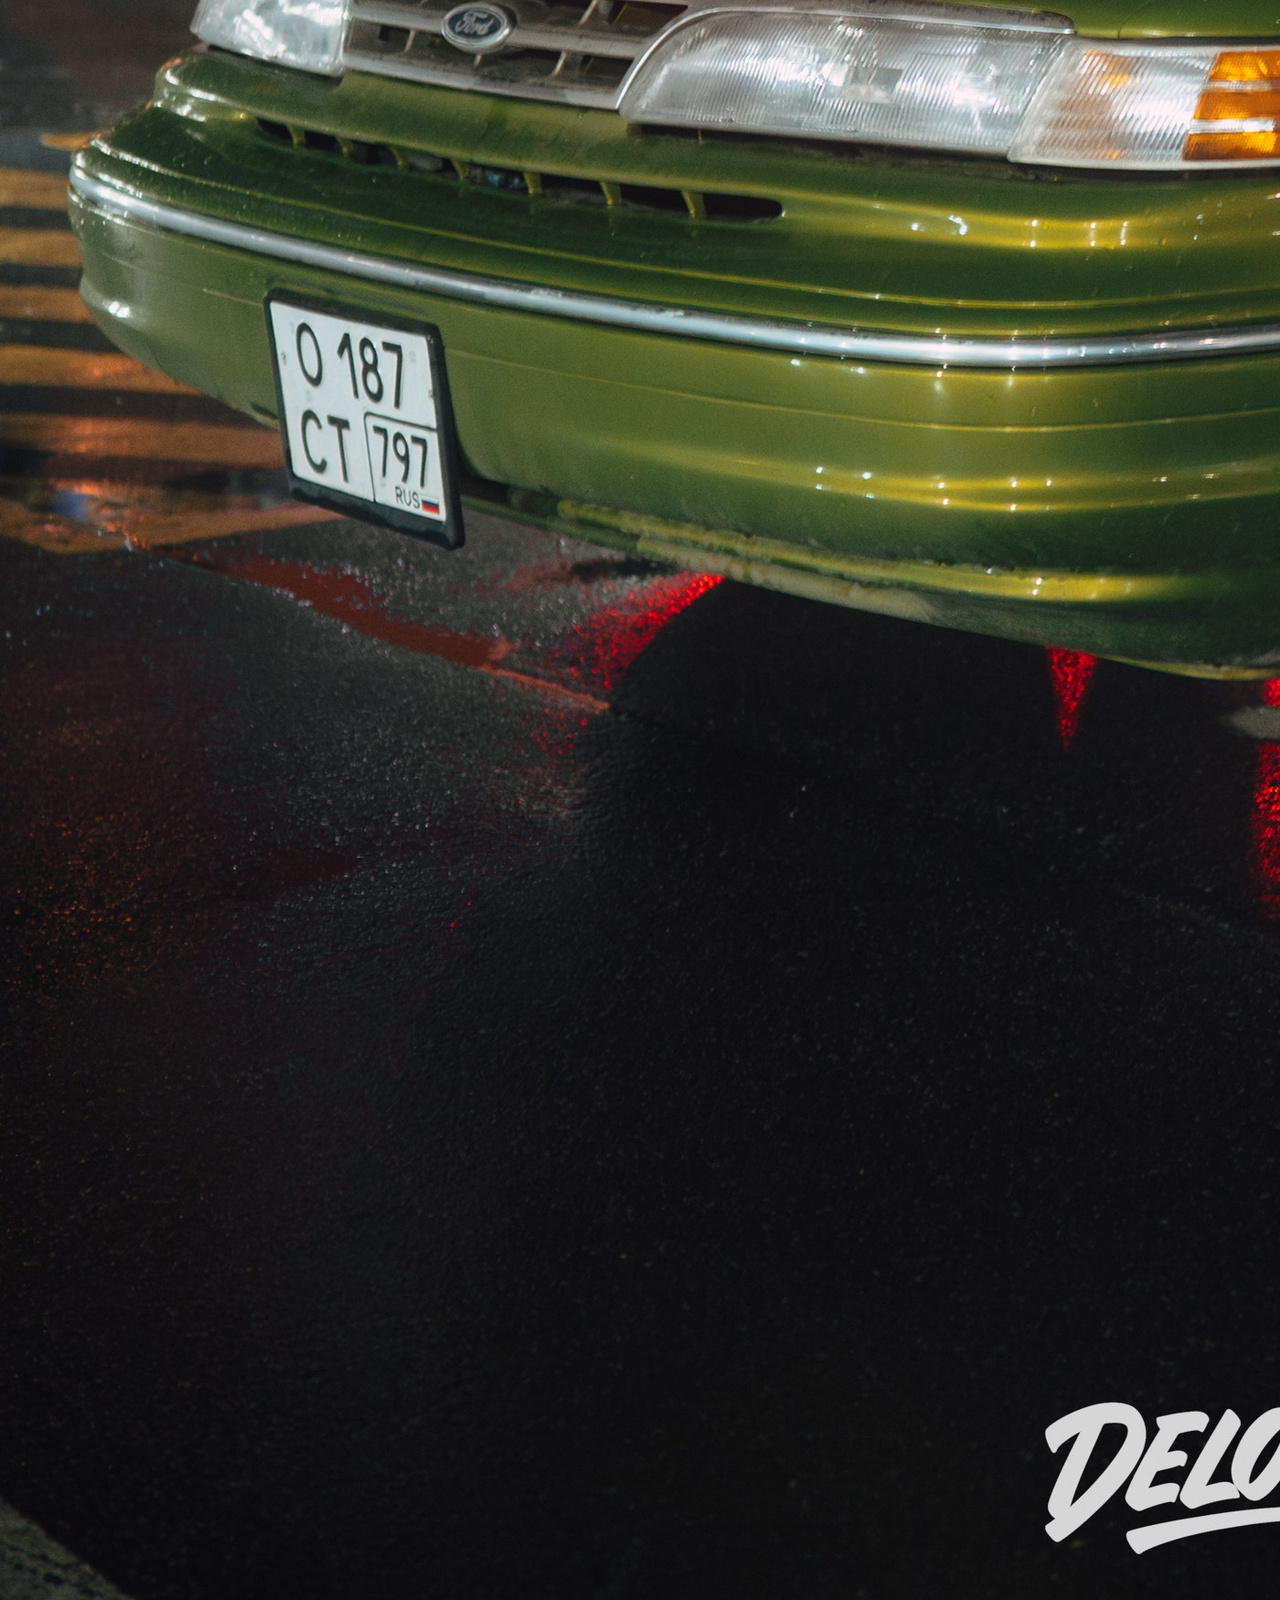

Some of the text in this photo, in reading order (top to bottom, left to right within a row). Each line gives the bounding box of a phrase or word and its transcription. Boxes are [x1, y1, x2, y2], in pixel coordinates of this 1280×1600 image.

[455, 11, 495, 35] Ford
[337, 333, 403, 409] 187
[373, 426, 428, 488] 797
[394, 486, 420, 509] RUS
